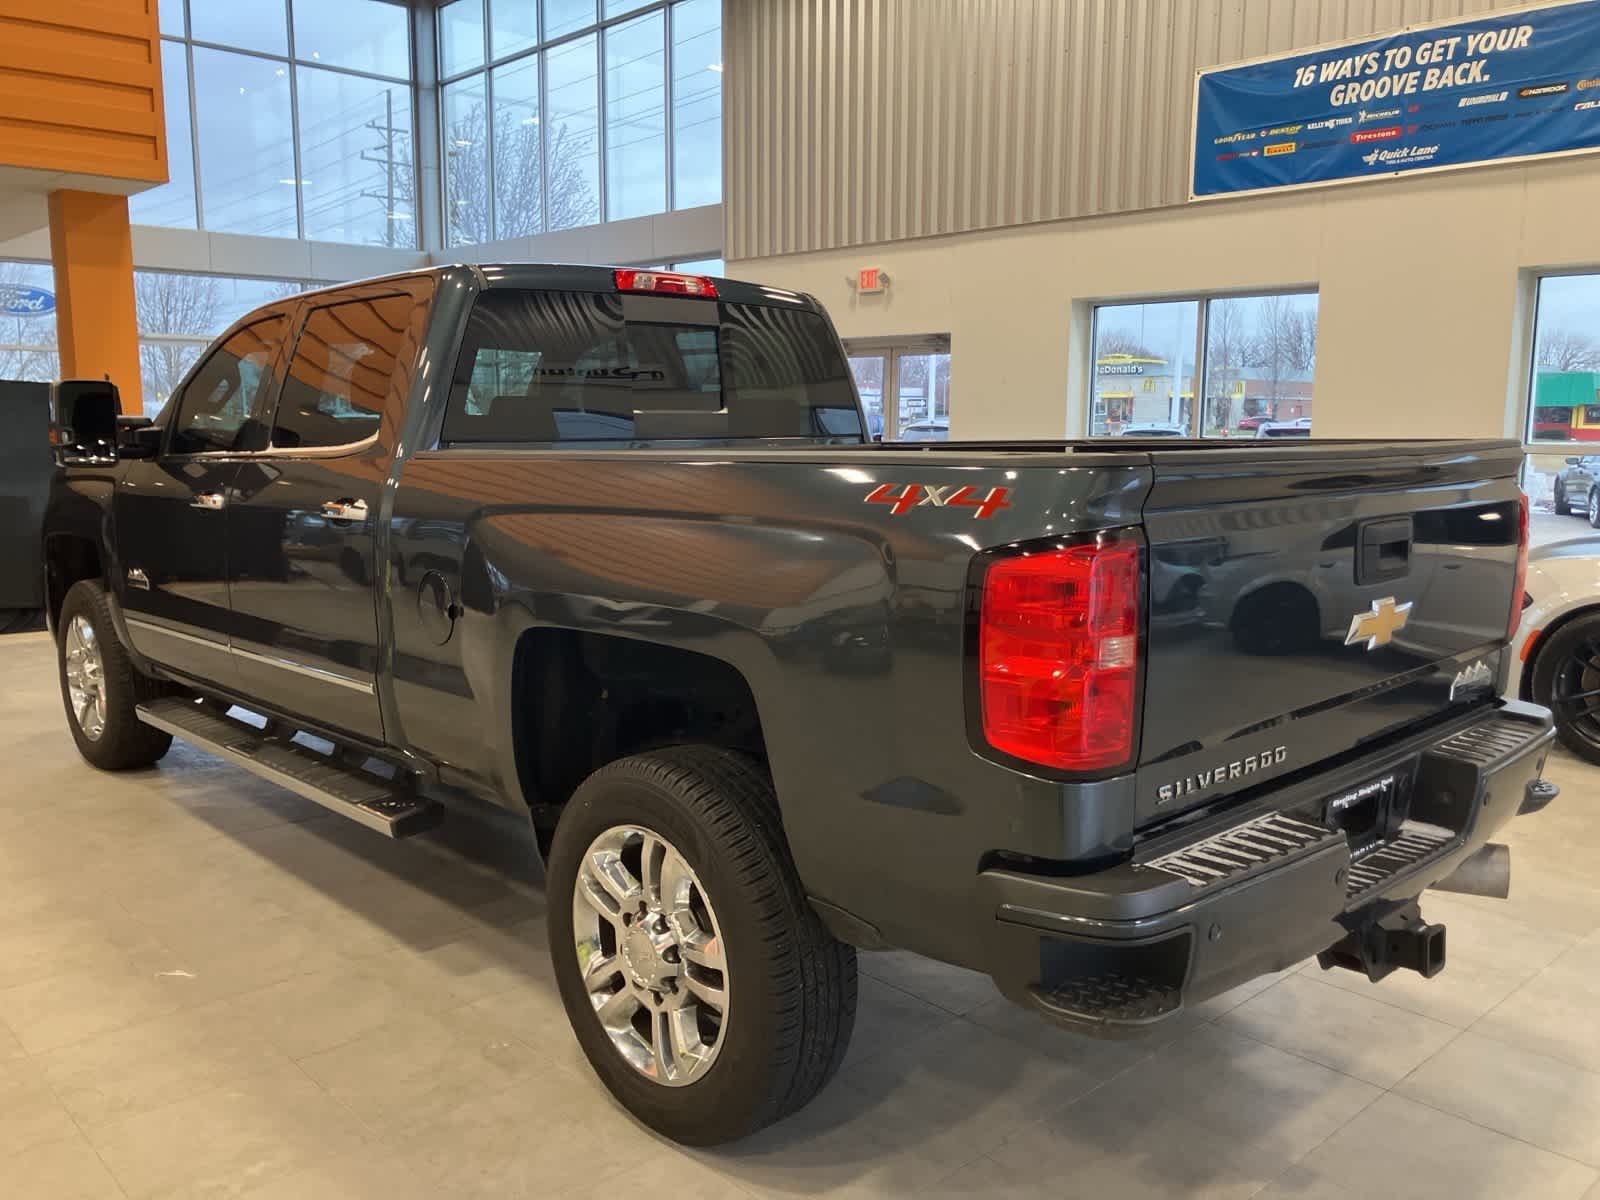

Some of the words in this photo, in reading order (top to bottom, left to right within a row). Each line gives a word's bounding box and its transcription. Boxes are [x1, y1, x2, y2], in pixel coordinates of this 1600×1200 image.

[1293, 64, 1317, 88] 16
[1319, 52, 1380, 83] WAYS
[1383, 47, 1411, 72] TO
[1415, 36, 1461, 65] GET
[1466, 25, 1534, 57] YOUR
[1330, 71, 1421, 107] GROOVE
[1422, 59, 1491, 92] BACK.
[1379, 147, 1409, 161] Quick
[1410, 145, 1439, 157] Lane
[860, 271, 877, 289] EXIT
[1096, 365, 1143, 375] cDonald's
[1157, 745, 1288, 806] SILVERADO
